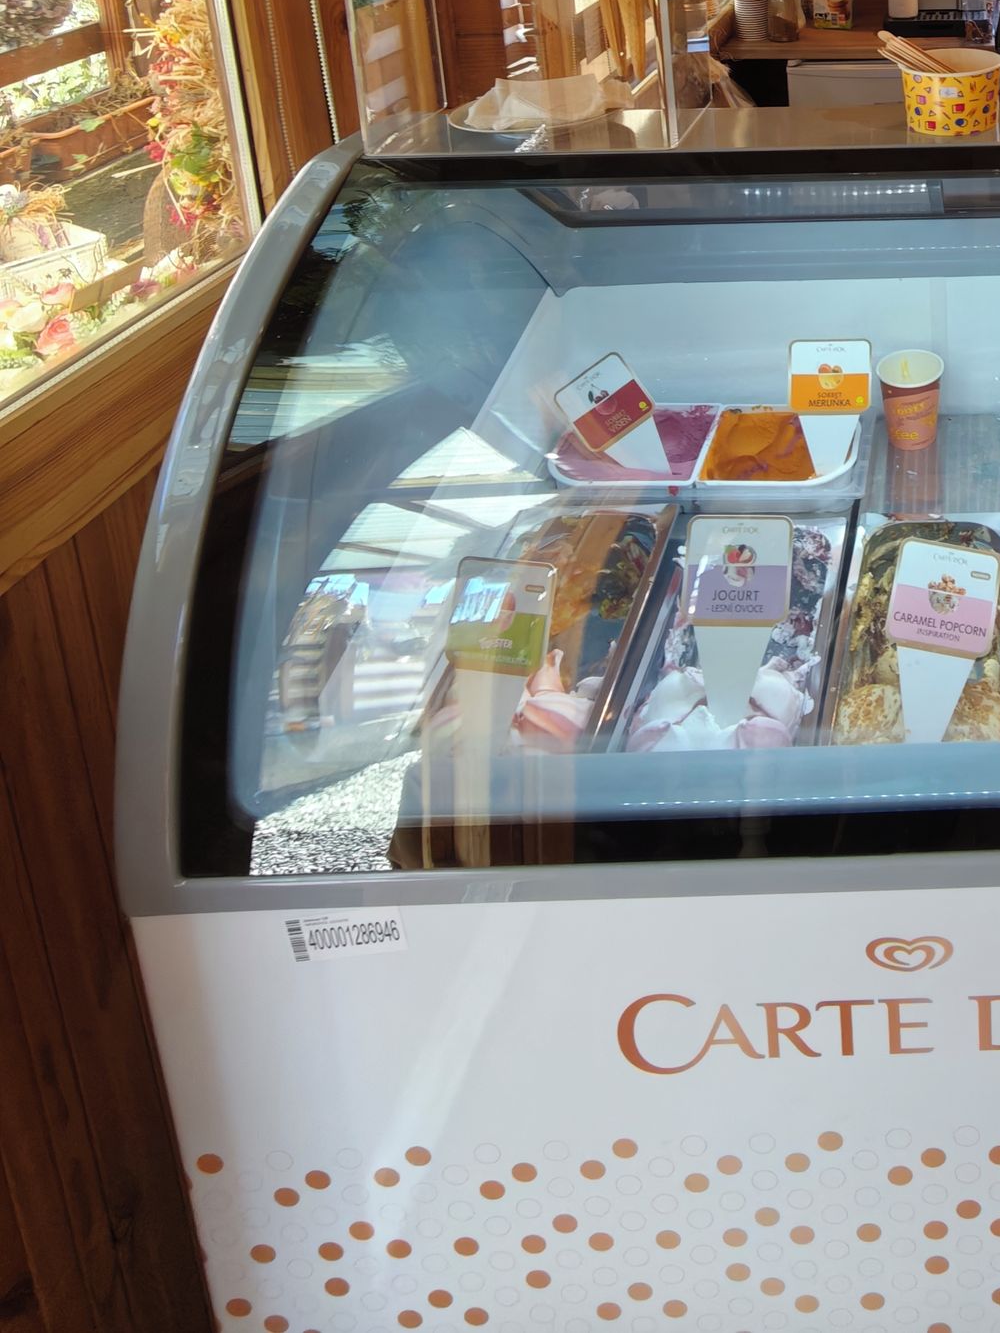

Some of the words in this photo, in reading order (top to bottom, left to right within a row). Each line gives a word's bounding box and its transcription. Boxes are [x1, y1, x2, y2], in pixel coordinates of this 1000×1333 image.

[712, 589, 760, 601] JOGURT
[734, 604, 765, 613] OVOCE
[893, 611, 937, 628] CARAMEL
[940, 620, 987, 637] POPCORN
[916, 628, 960, 642] INSPIRATION
[308, 920, 400, 951] 400001286946
[616, 993, 935, 1076] CARTE
